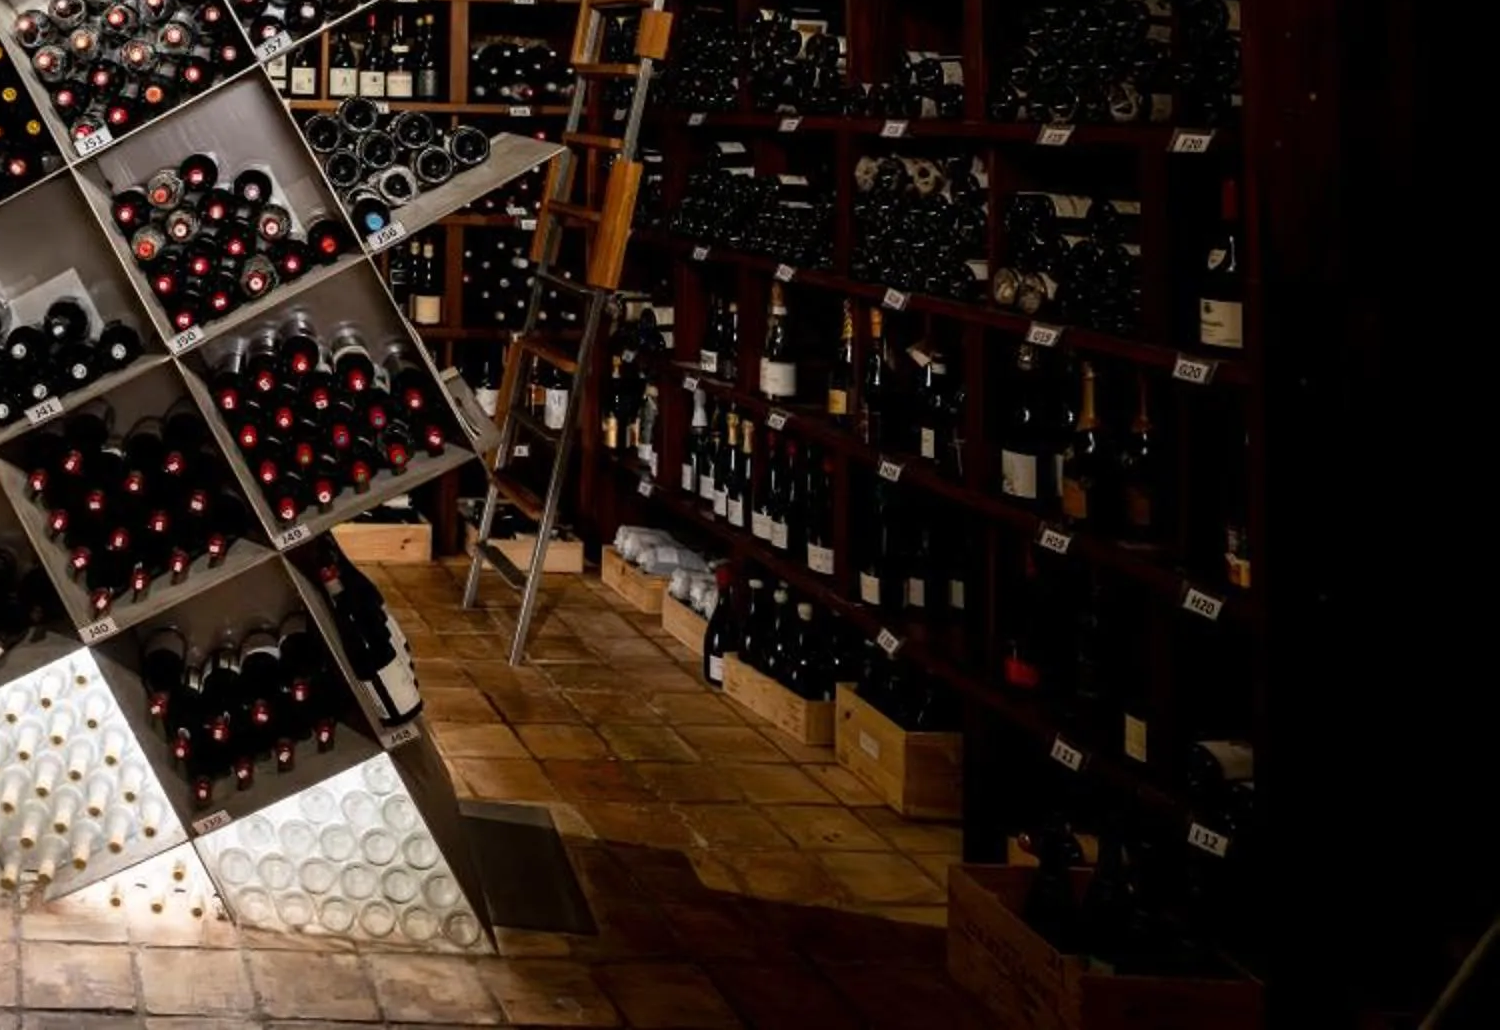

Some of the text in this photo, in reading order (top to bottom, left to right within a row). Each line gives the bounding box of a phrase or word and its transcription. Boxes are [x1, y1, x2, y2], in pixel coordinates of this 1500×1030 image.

[265, 38, 282, 56] J57
[84, 135, 103, 151] J51
[377, 227, 398, 244] J56
[176, 332, 197, 348] J50
[1180, 364, 1202, 380] G20
[36, 404, 56, 418] J41
[282, 529, 302, 544] J49
[1191, 594, 1215, 615] H20
[89, 624, 109, 638] J40
[203, 816, 223, 830] J39
